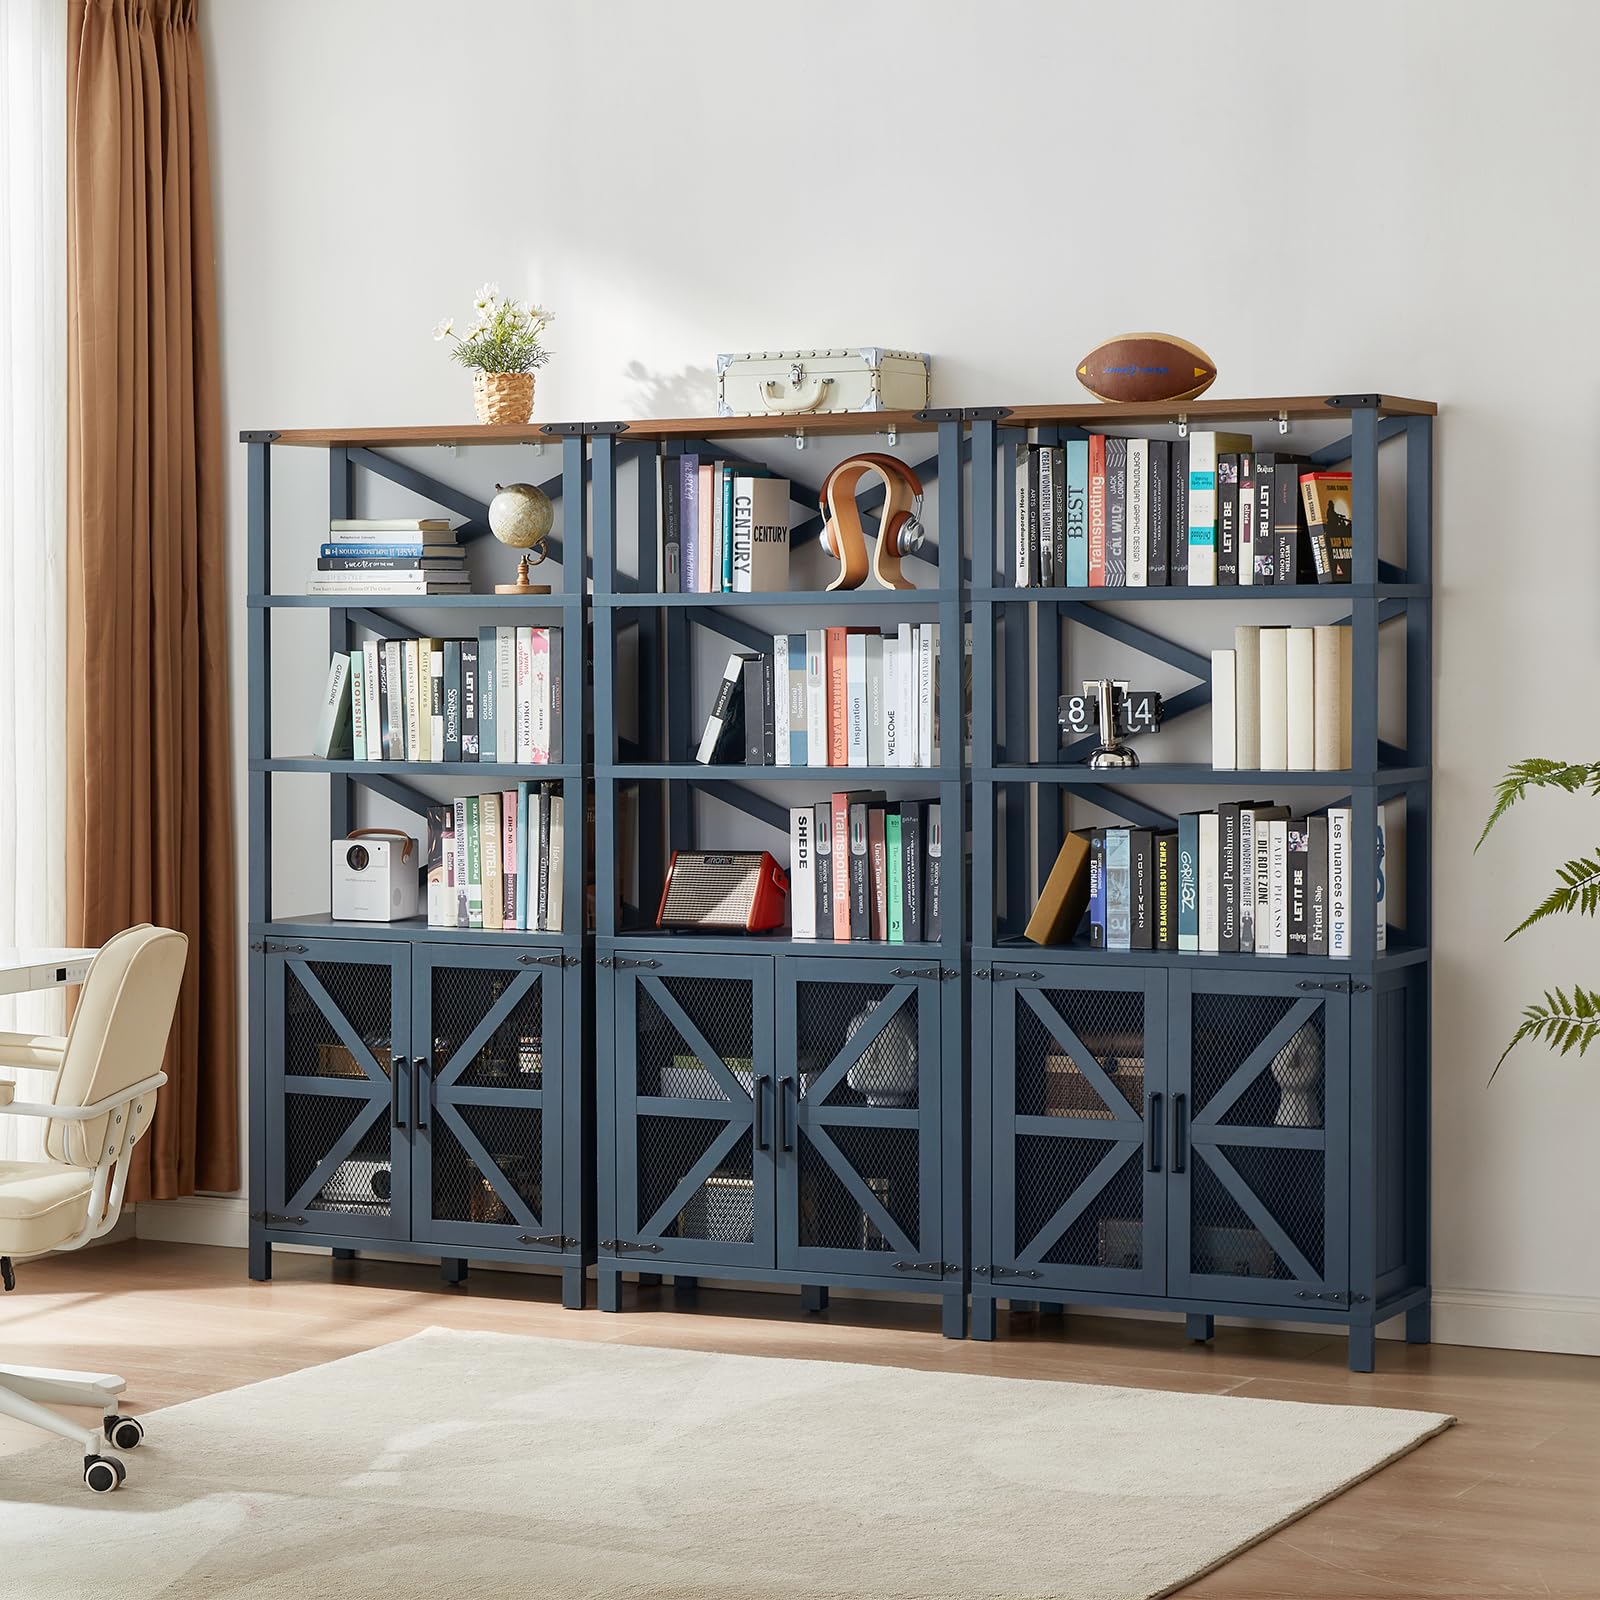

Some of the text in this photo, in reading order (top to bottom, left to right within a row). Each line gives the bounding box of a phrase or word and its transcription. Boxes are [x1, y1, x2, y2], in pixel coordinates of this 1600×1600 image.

[1042, 451, 1051, 541] CREATE WONDERFUL HOMELIFE
[1067, 485, 1083, 539] BEST
[1111, 505, 1122, 533] WILD
[1133, 504, 1141, 535] GRAPHIC
[1260, 485, 1269, 537] LET IT BE
[734, 496, 751, 574] CENTURY
[754, 526, 787, 543] CENTURY
[1133, 536, 1141, 562] DESIGN
[1223, 501, 1232, 553] LET IT BE
[328, 664, 342, 706] GERALDINE
[501, 635, 509, 689] SPECIAL ISSUE
[447, 688, 457, 716] RINGS
[466, 692, 473, 702] IT
[466, 704, 473, 719] BE
[715, 681, 732, 717] Expo Express
[833, 668, 842, 760] CASTA LAETITIA
[853, 697, 861, 746] Inspiration
[1068, 696, 1086, 724] 8
[1122, 698, 1152, 725] 14
[447, 721, 457, 742] LORD
[456, 802, 466, 886] CREATE WONDERFUL HOMELIFE
[484, 800, 497, 877] LUXURY HOTELS
[508, 834, 514, 844] UN
[798, 815, 807, 870] SHEDE
[834, 808, 847, 901] Trainspotting
[874, 842, 882, 865] Uncle
[1242, 814, 1252, 907] CREATE WONDERFUL HOMELIFE
[1258, 840, 1268, 854] DIE
[1159, 841, 1167, 942] LES BANQUIERS DU TEMPS
[1180, 851, 1196, 914] GORILLAZ
[1223, 815, 1234, 939] Crime and Punishment
[1258, 856, 1268, 880] ROTE
[1258, 881, 1268, 905] ZONE
[1274, 836, 1282, 938] PABLO PICASSO
[1333, 816, 1345, 949] Les nuances de bleu
[508, 910, 514, 920] LA
[1294, 869, 1303, 922] LET IT BE
[1313, 885, 1323, 941] Friend Ship
